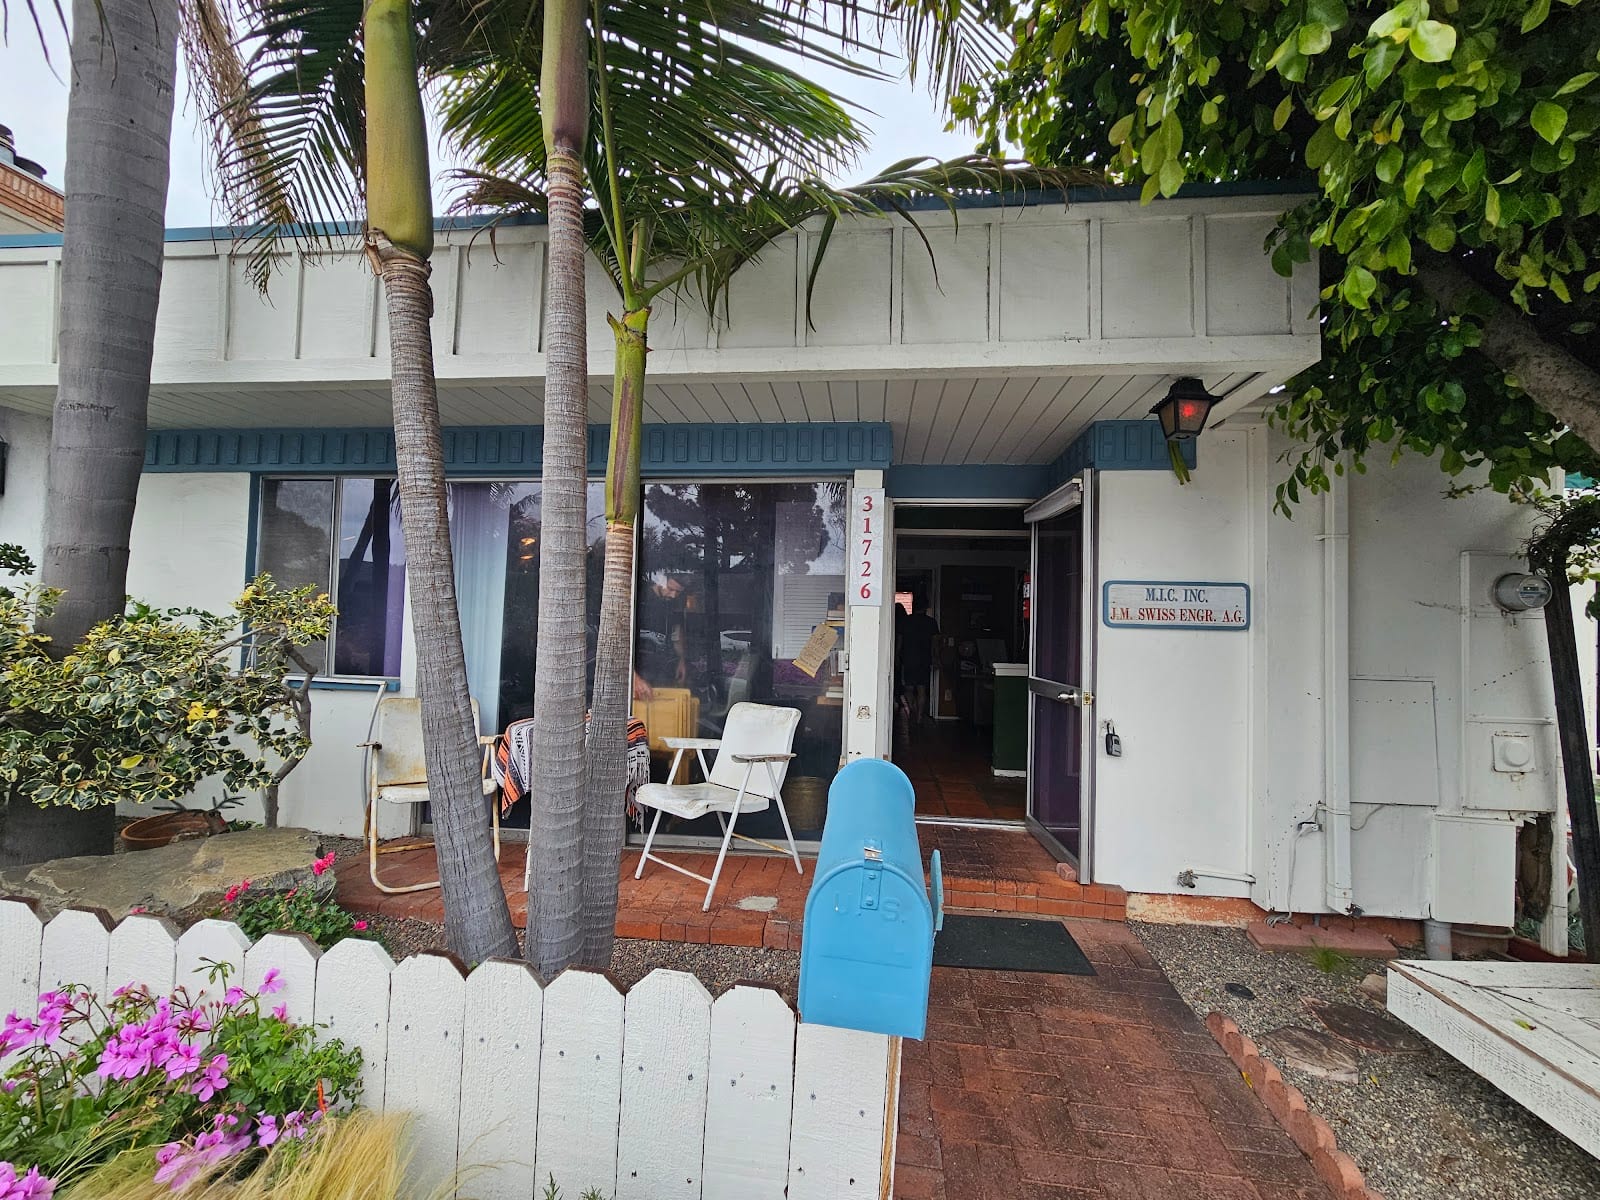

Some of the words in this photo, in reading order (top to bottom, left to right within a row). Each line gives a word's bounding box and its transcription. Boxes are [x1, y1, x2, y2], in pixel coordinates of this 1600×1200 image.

[860, 495, 873, 599] 31726
[1145, 588, 1178, 602] M.I.C.
[1184, 589, 1208, 603] INC.
[1138, 608, 1176, 621] SWISS
[1180, 608, 1217, 622] ENGR.
[1222, 609, 1245, 623] A.G.
